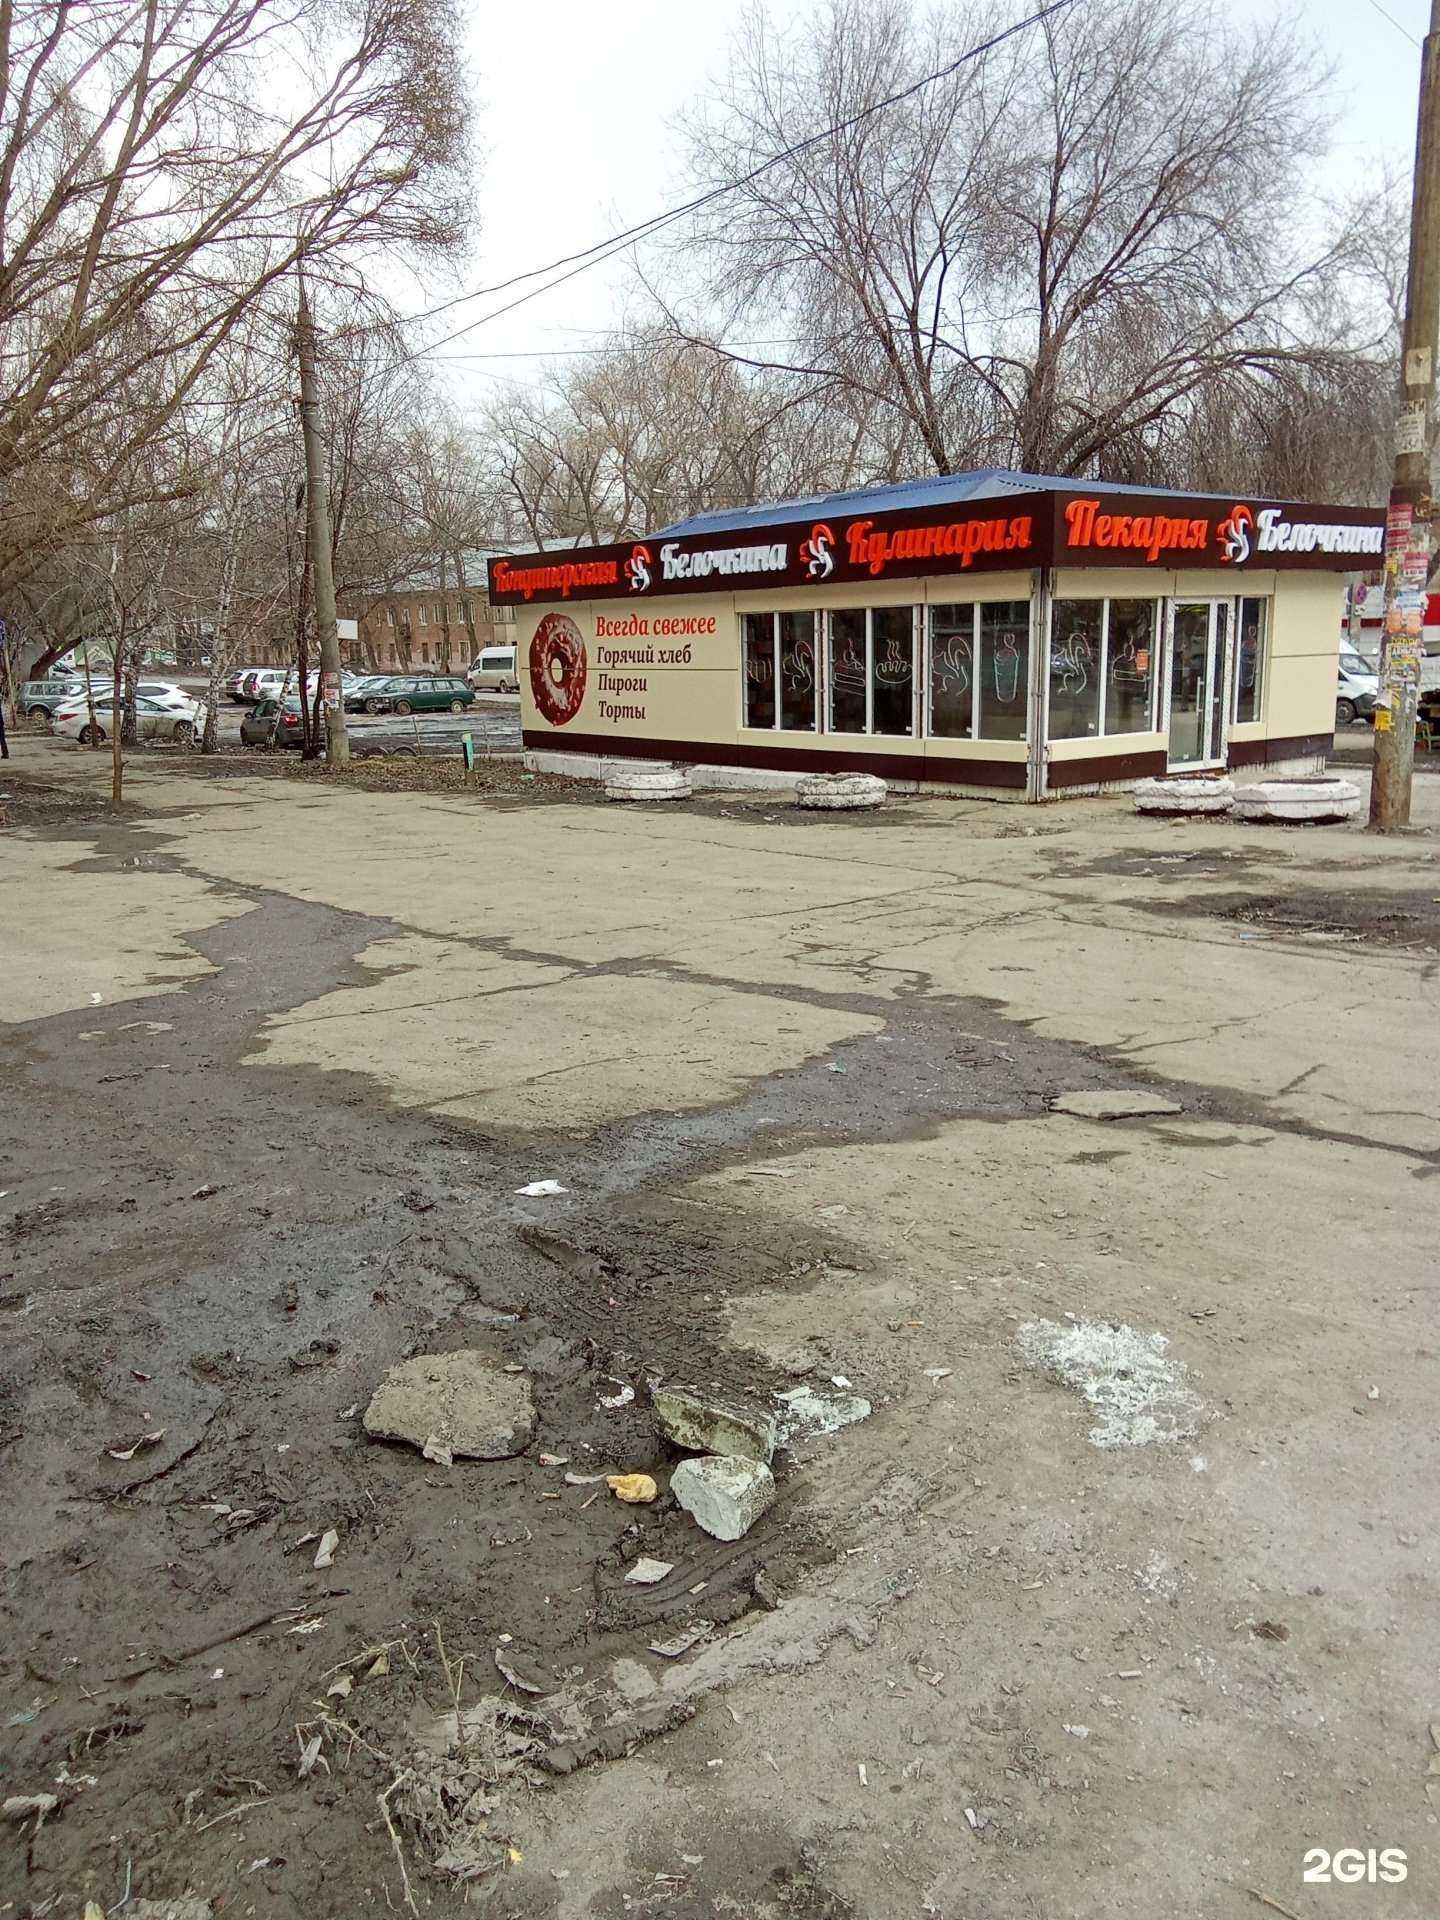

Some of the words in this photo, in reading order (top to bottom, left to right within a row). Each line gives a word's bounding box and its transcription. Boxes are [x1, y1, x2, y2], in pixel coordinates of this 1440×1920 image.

[1065, 499, 1208, 562] Пекарня
[1257, 509, 1384, 554] Белочкина
[493, 561, 618, 599] Кондитерская
[660, 543, 788, 580] Белочкина
[846, 516, 1032, 575] Кулинария
[596, 613, 649, 636] Всегда
[653, 616, 716, 635] свежее
[597, 644, 655, 668] Горячий
[658, 643, 692, 664] хлеб
[598, 673, 648, 696] Пироги
[598, 700, 646, 722] Торты
